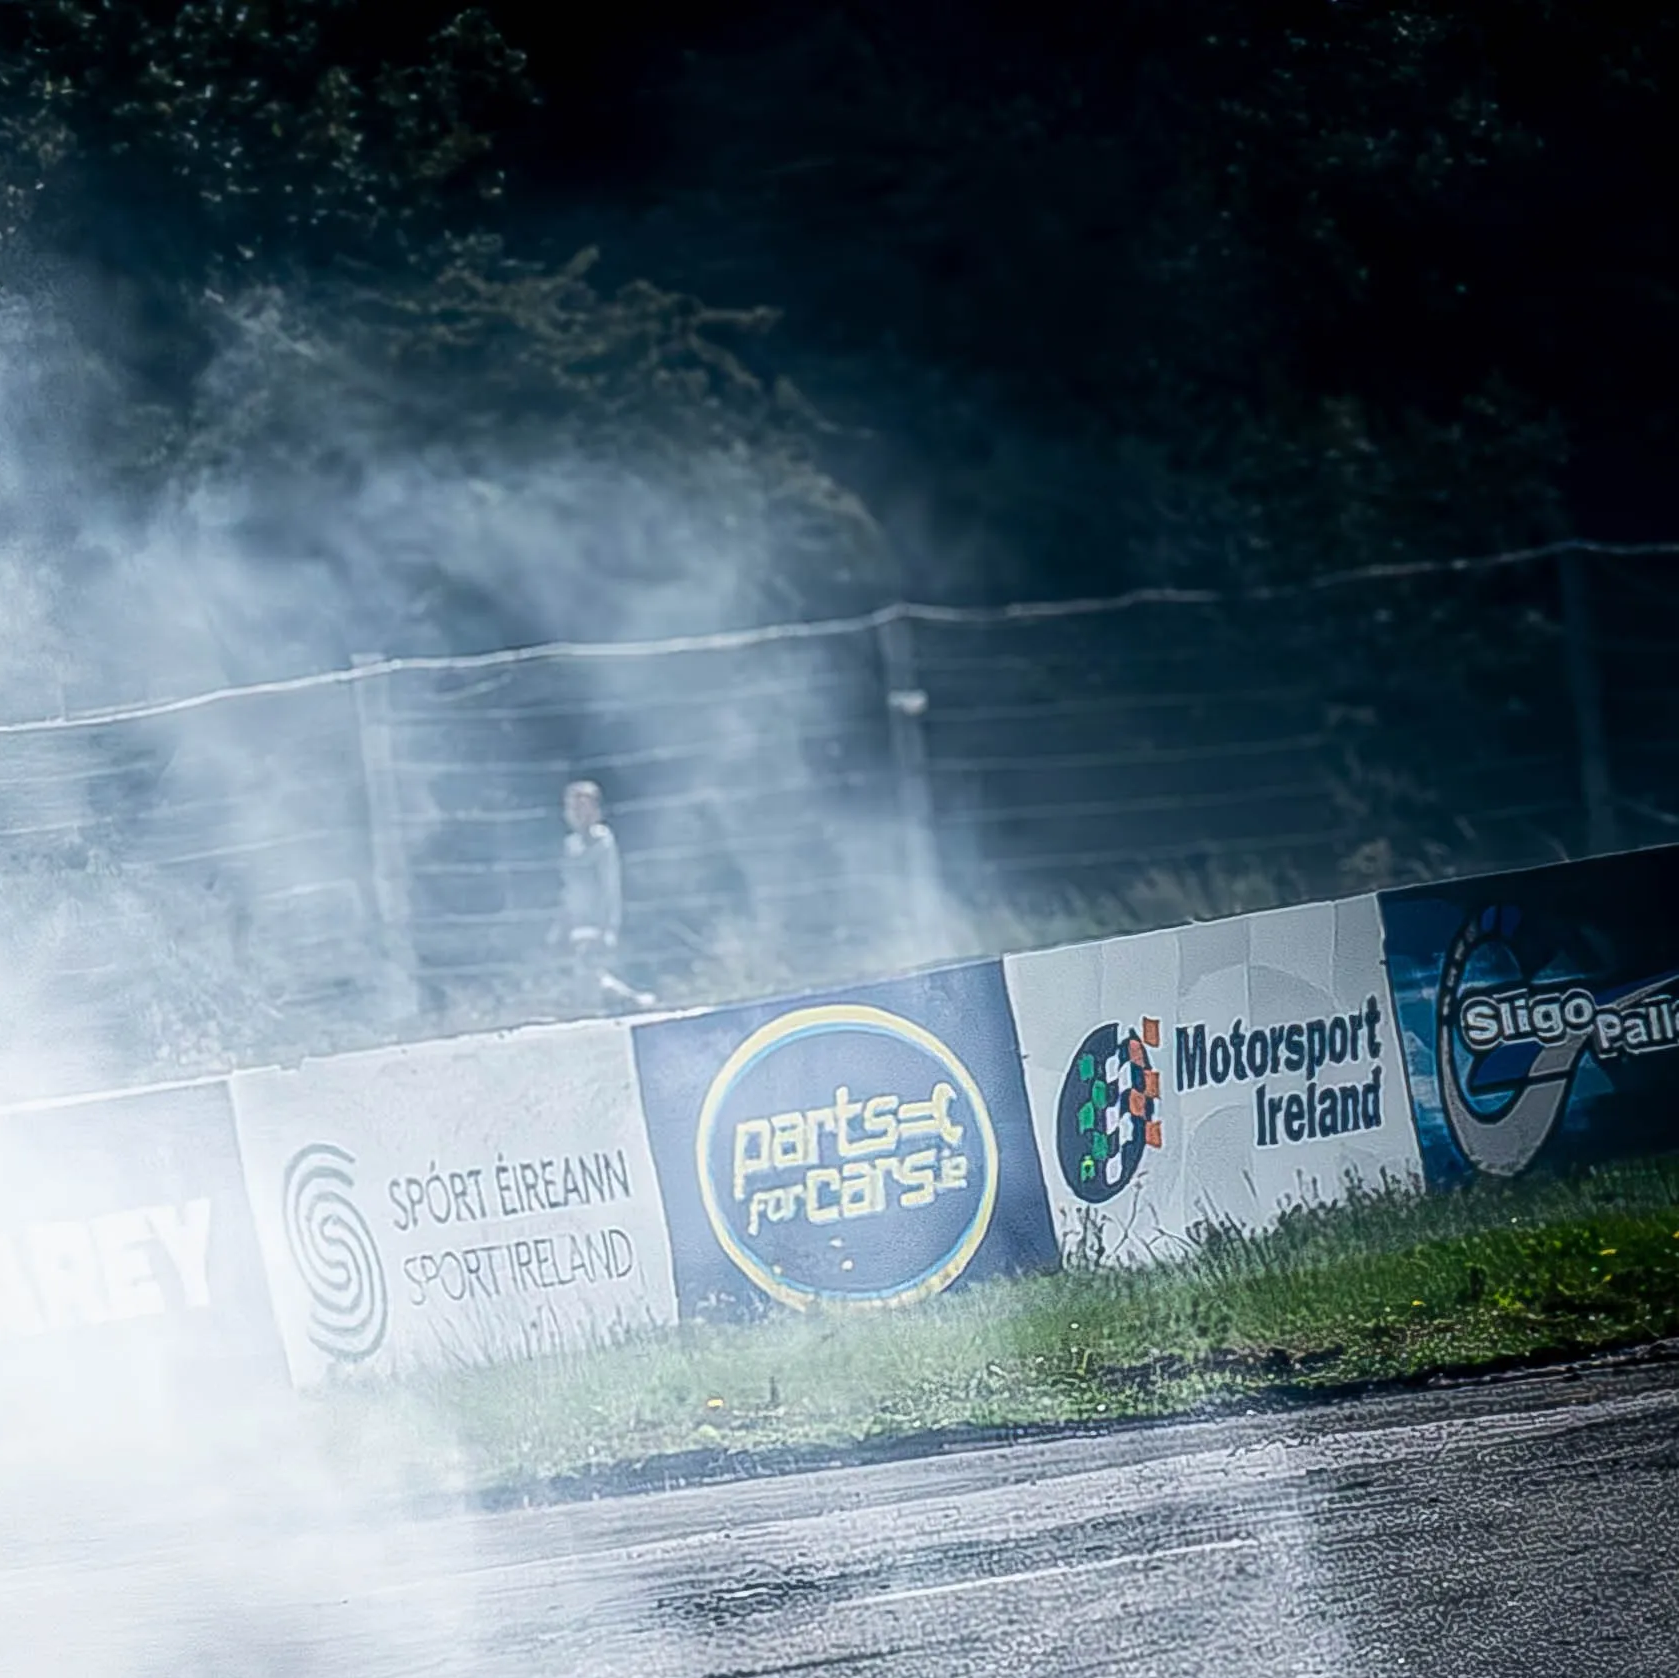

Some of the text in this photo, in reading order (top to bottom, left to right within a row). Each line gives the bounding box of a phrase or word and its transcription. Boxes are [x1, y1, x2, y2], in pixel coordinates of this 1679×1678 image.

[1175, 998, 1381, 1093] Motorsport
[1465, 998, 1593, 1041] Sligo
[734, 1085, 900, 1200] parts
[1255, 1068, 1383, 1147] Ireland
[388, 1149, 632, 1232] SPÓRT ÉIREANN
[748, 1184, 805, 1236] for
[403, 1229, 634, 1306] SPORT IRELAND
